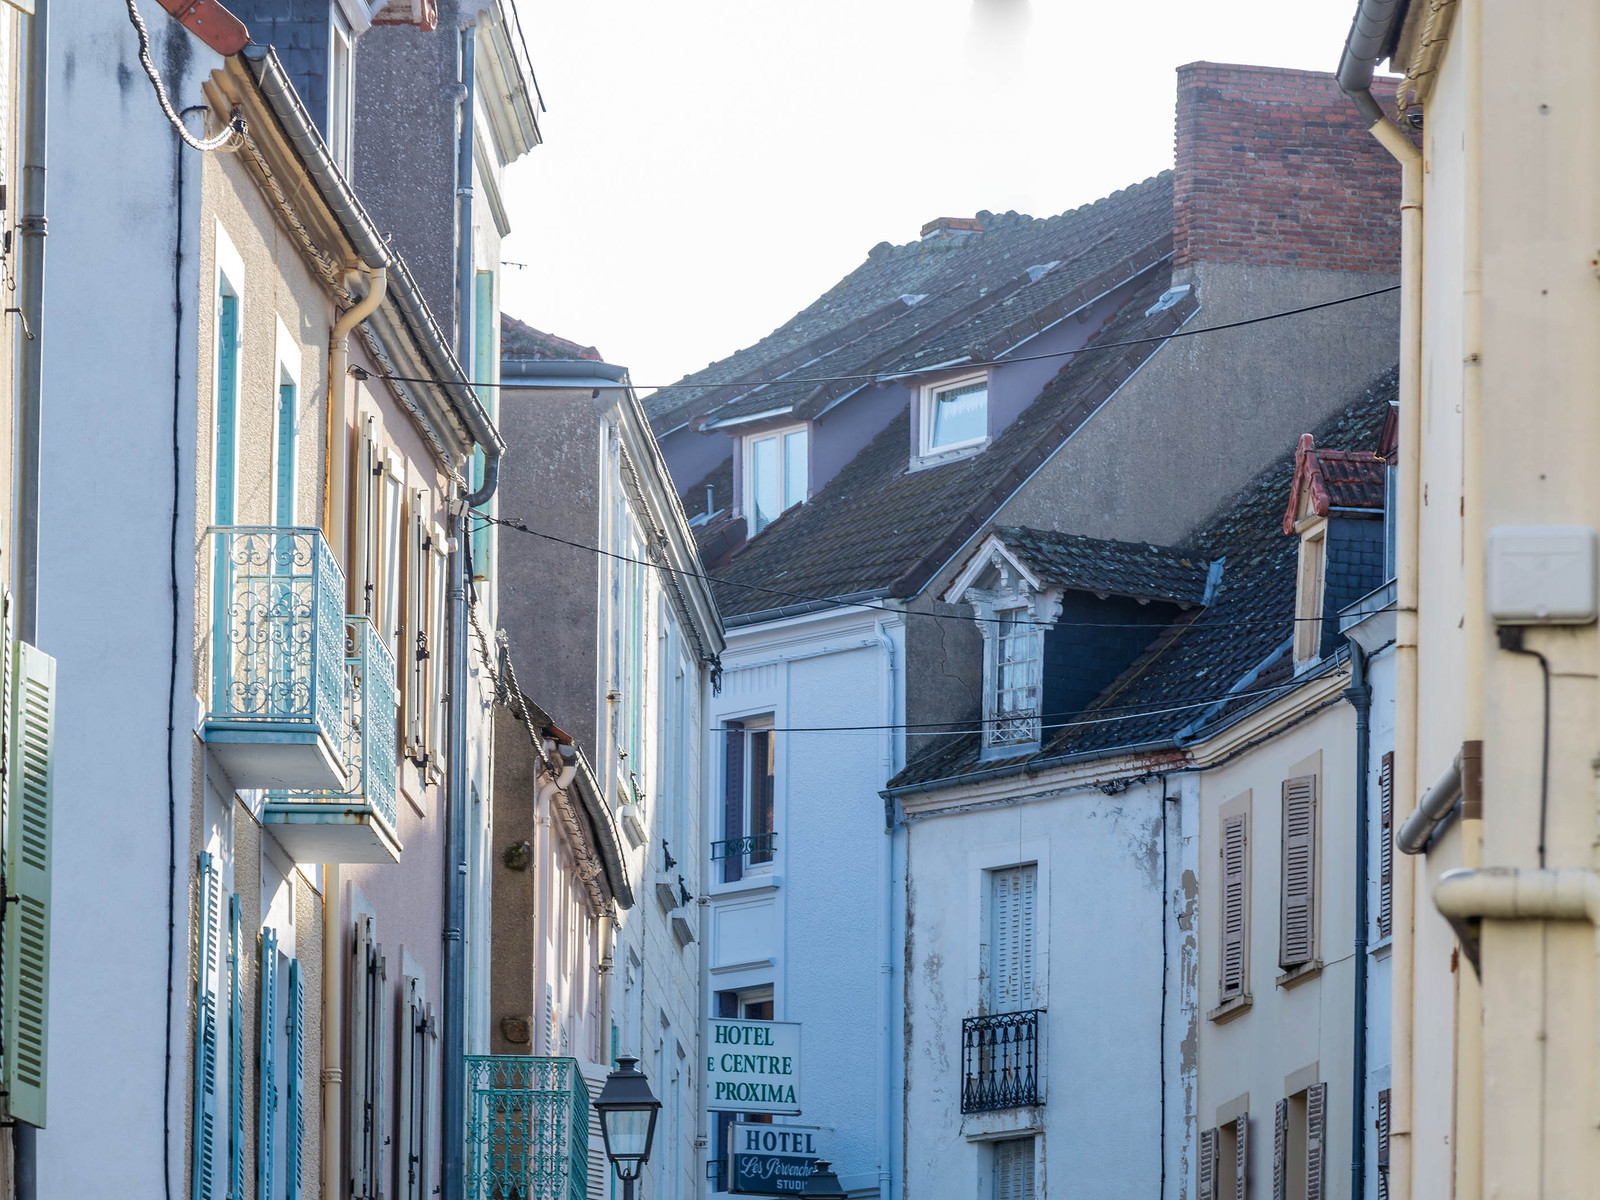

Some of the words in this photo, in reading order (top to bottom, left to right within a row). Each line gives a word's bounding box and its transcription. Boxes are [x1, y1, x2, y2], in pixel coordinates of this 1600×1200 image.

[714, 1024, 775, 1046] HOTEL
[721, 1053, 793, 1075] CENTRE
[715, 1081, 797, 1104] PROXIMA
[745, 1129, 817, 1154] HOTEL
[740, 1156, 763, 1177] Les
[776, 1179, 808, 1191] STUDI
